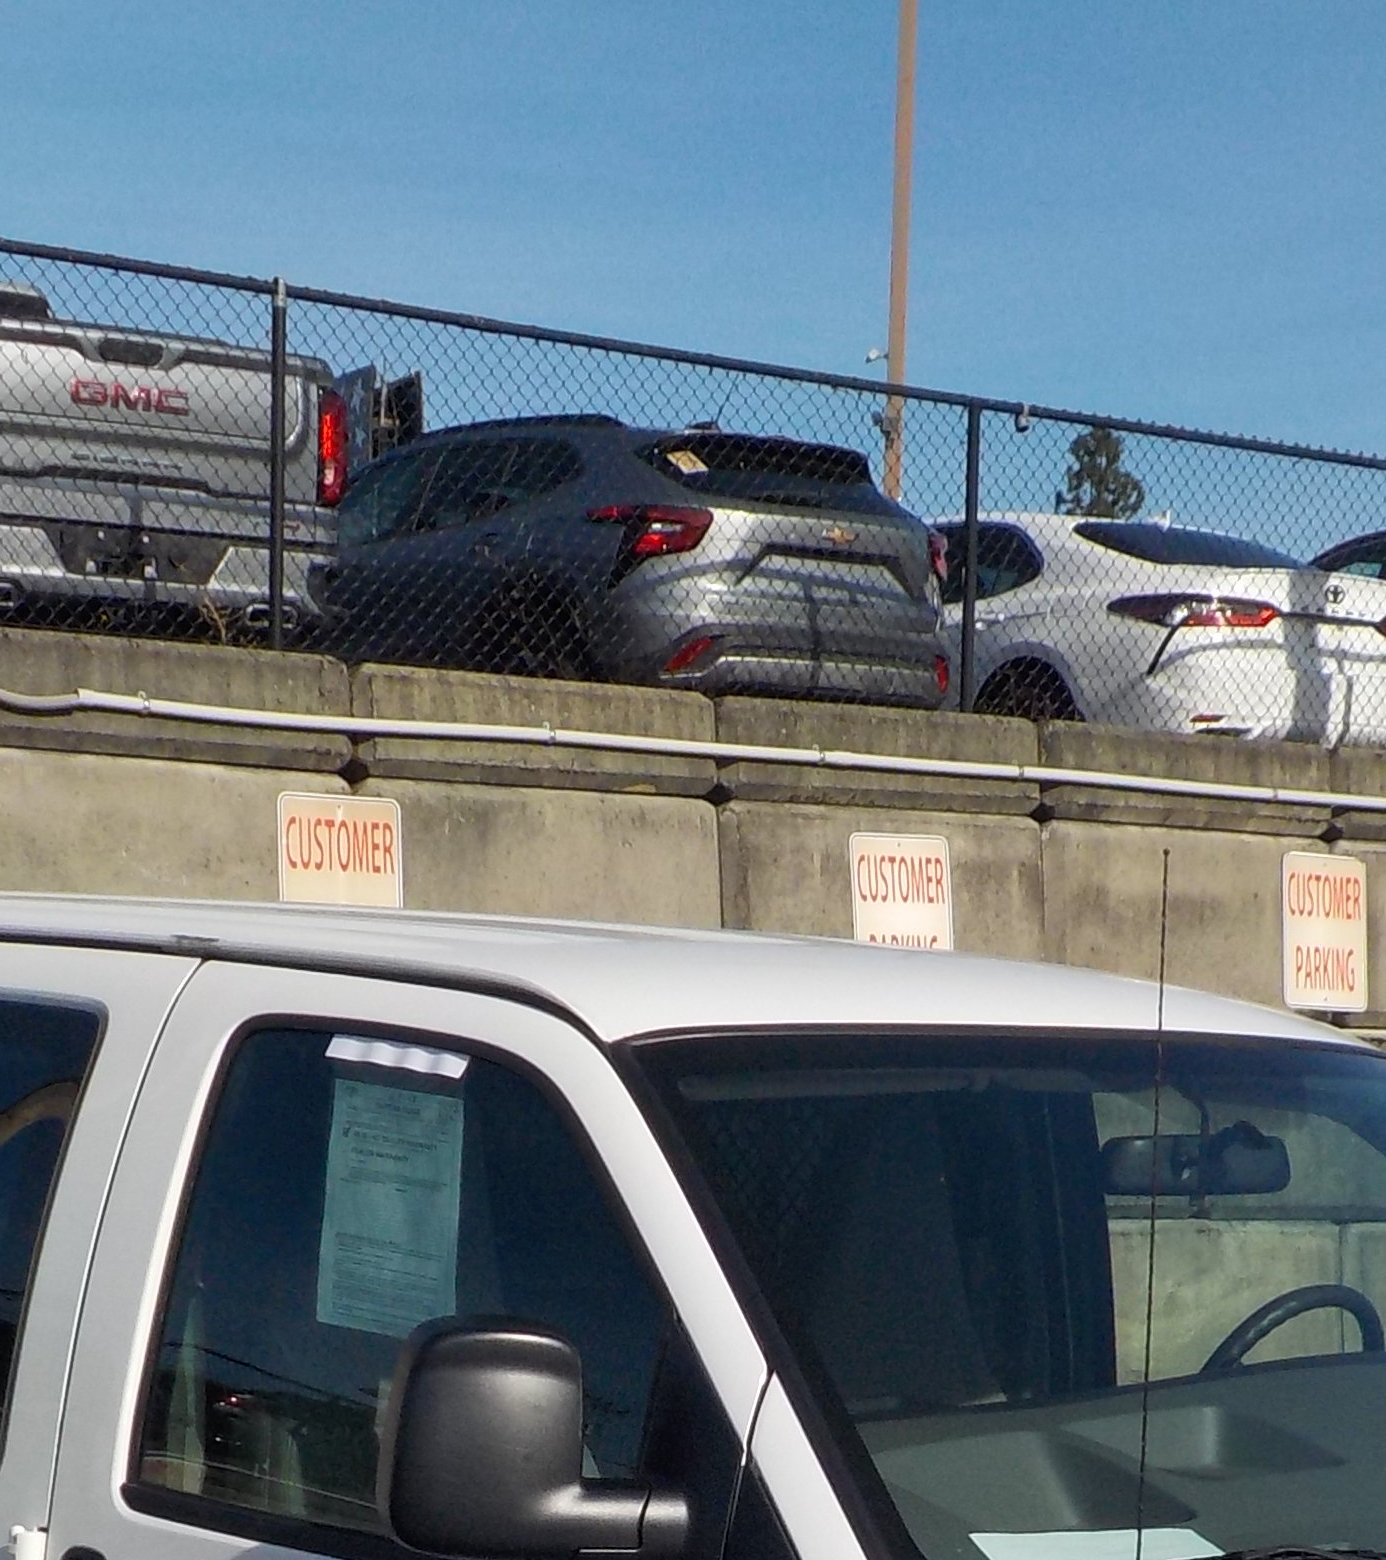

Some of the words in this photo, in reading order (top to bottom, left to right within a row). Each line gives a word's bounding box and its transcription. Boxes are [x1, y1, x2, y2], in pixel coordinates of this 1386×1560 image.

[70, 378, 190, 417] GMC
[285, 815, 395, 875] CUSTOMER
[856, 853, 946, 905] CUSTOMER
[1287, 871, 1362, 921] CUSTOMER
[1295, 945, 1356, 992] PARKING
